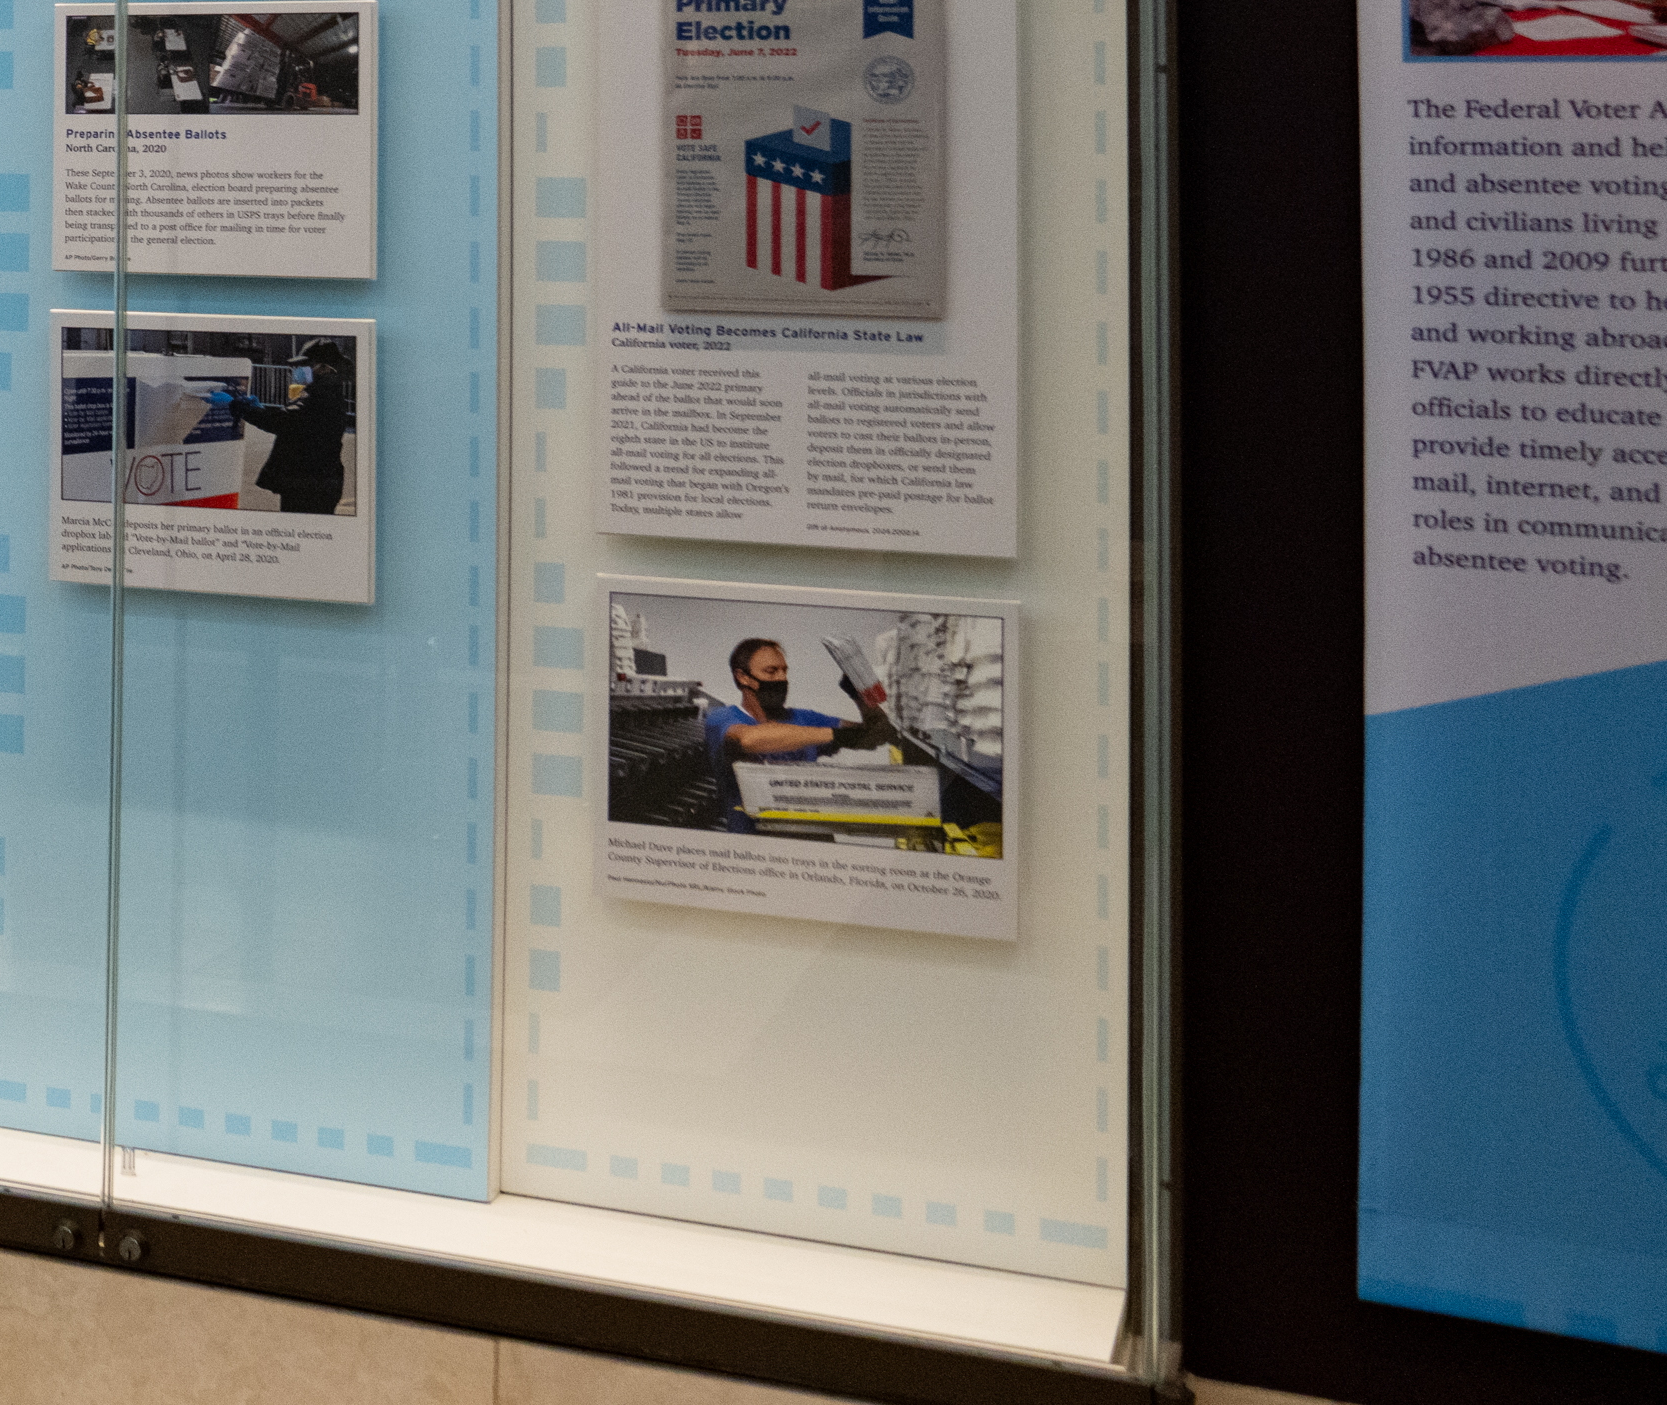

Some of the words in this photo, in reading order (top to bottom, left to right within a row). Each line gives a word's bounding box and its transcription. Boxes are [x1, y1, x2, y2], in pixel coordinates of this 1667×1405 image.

[677, 21, 790, 40] Election
[1408, 98, 1455, 118] The
[1466, 98, 1560, 119] Federal
[1569, 100, 1640, 119] Voter
[126, 128, 181, 140] Absentee
[184, 129, 227, 140] Ballots
[612, 321, 664, 334] All-Mail
[668, 323, 712, 338] Voting
[716, 324, 777, 338] Becomes
[781, 327, 849, 341] California
[853, 329, 892, 342] State
[896, 331, 924, 343] Law
[1414, 546, 1526, 572] absentee
[1537, 557, 1627, 583] voting.
